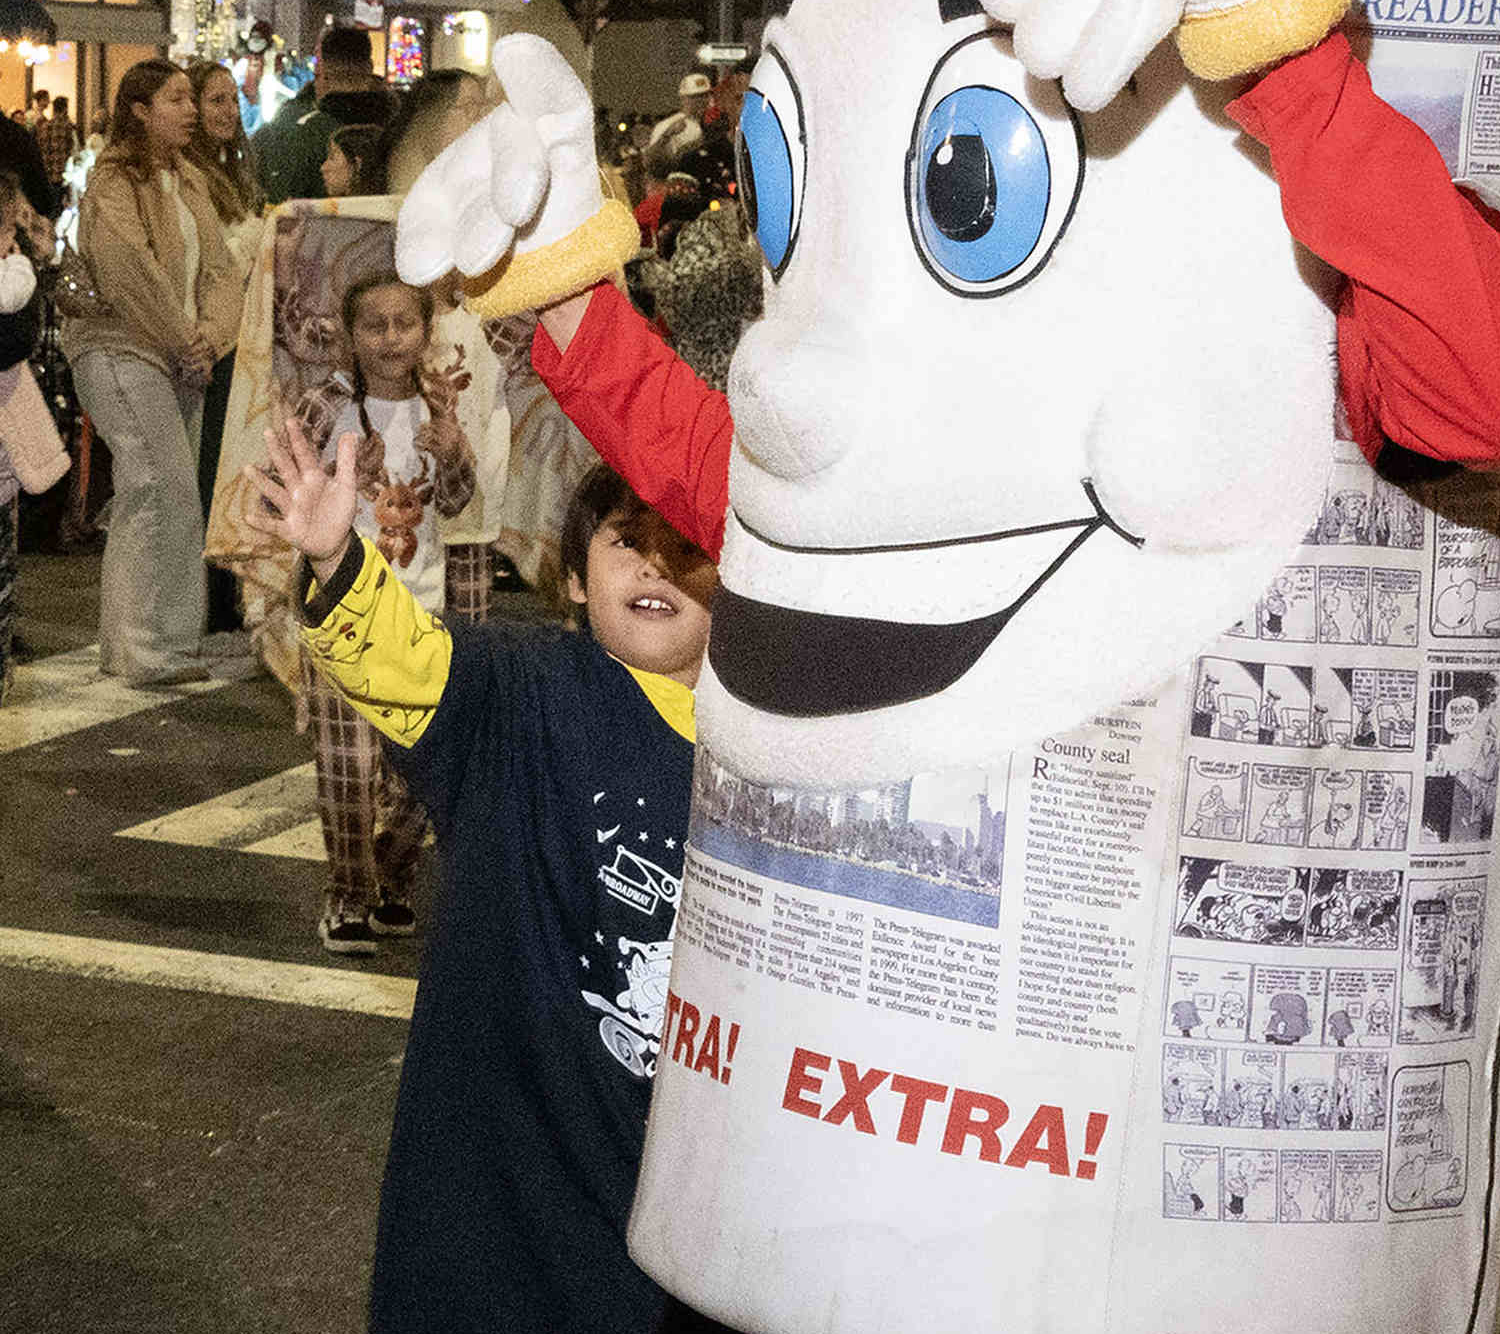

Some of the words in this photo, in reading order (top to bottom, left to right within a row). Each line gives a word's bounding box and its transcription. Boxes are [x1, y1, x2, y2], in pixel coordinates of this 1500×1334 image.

[1041, 737, 1096, 764] County
[1101, 749, 1131, 764] seal
[781, 1047, 1110, 1181] EXTRA!
